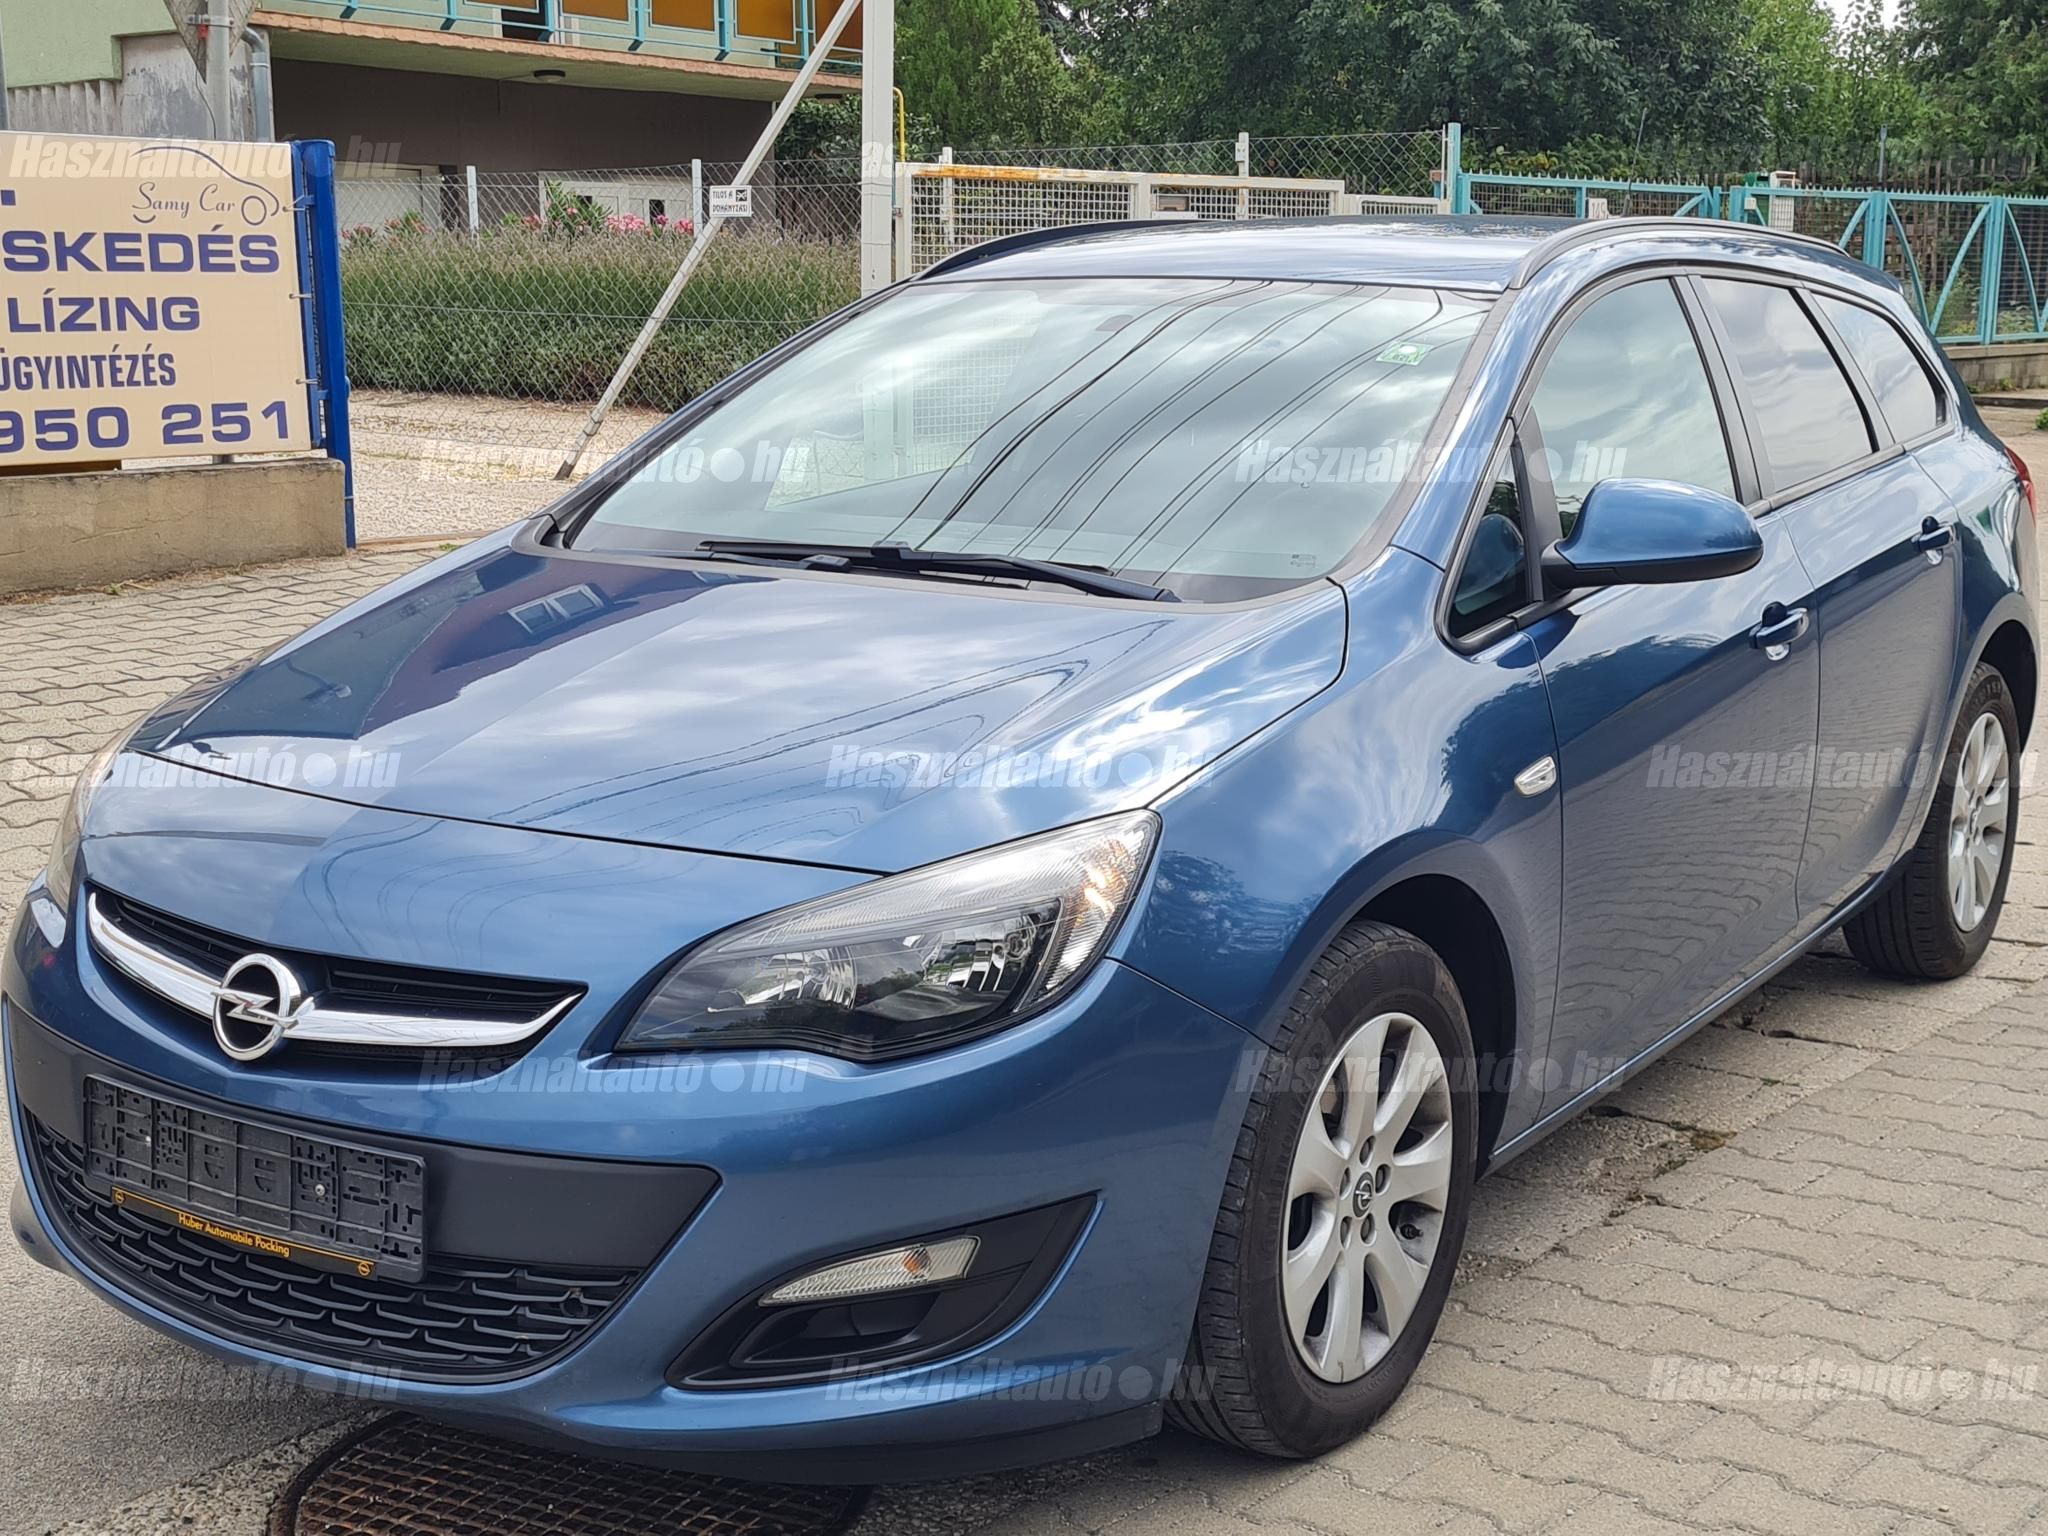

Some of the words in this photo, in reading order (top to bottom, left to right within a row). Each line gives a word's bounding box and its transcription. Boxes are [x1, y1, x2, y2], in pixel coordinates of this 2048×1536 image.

[132, 182, 190, 218] Samy
[200, 184, 235, 212] Car
[2, 224, 279, 273] SKEDÉS
[7, 288, 200, 333] LÍZING
[162, 401, 289, 445] 251
[178, 1213, 203, 1230] Huber
[205, 1223, 253, 1246] Automobile
[255, 1236, 290, 1257] Pocking
